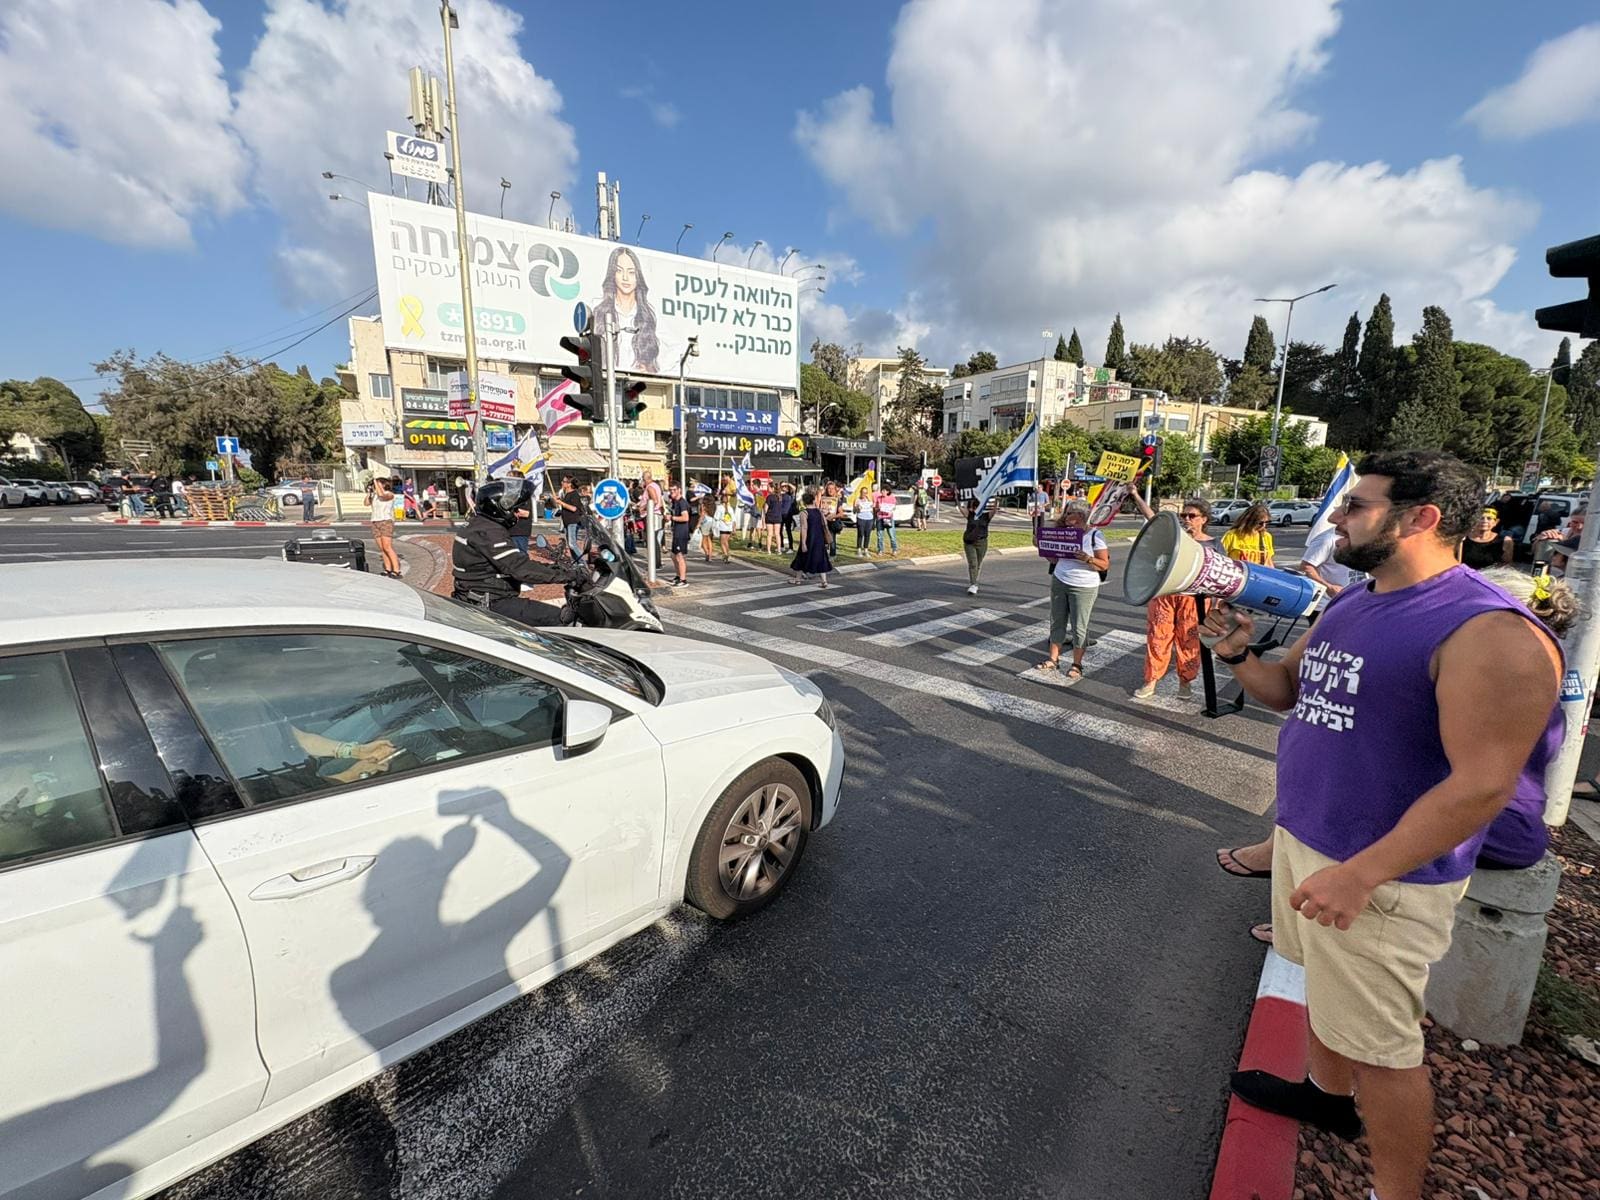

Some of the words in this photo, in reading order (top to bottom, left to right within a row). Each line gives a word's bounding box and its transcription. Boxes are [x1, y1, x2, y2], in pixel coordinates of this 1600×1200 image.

[392, 255, 460, 278] עסקים
[475, 269, 521, 289] העוגן
[675, 273, 728, 298] לעסק
[733, 284, 792, 309] הלוואה
[662, 297, 727, 325] לוקחים
[732, 307, 756, 327] לא
[761, 313, 792, 332] כבר
[440, 331, 526, 351] tzma.org.il
[716, 334, 792, 355] מהבנק...
[746, 412, 773, 424] א.ב
[738, 437, 752, 452] של
[754, 438, 785, 455] השוק
[1107, 462, 1128, 472] עדיין
[1119, 457, 1136, 465] למה
[1102, 468, 1129, 481] בעזה?
[1299, 654, 1328, 681] שלו
[1324, 665, 1360, 694] רק
[1306, 707, 1354, 732] יביא
